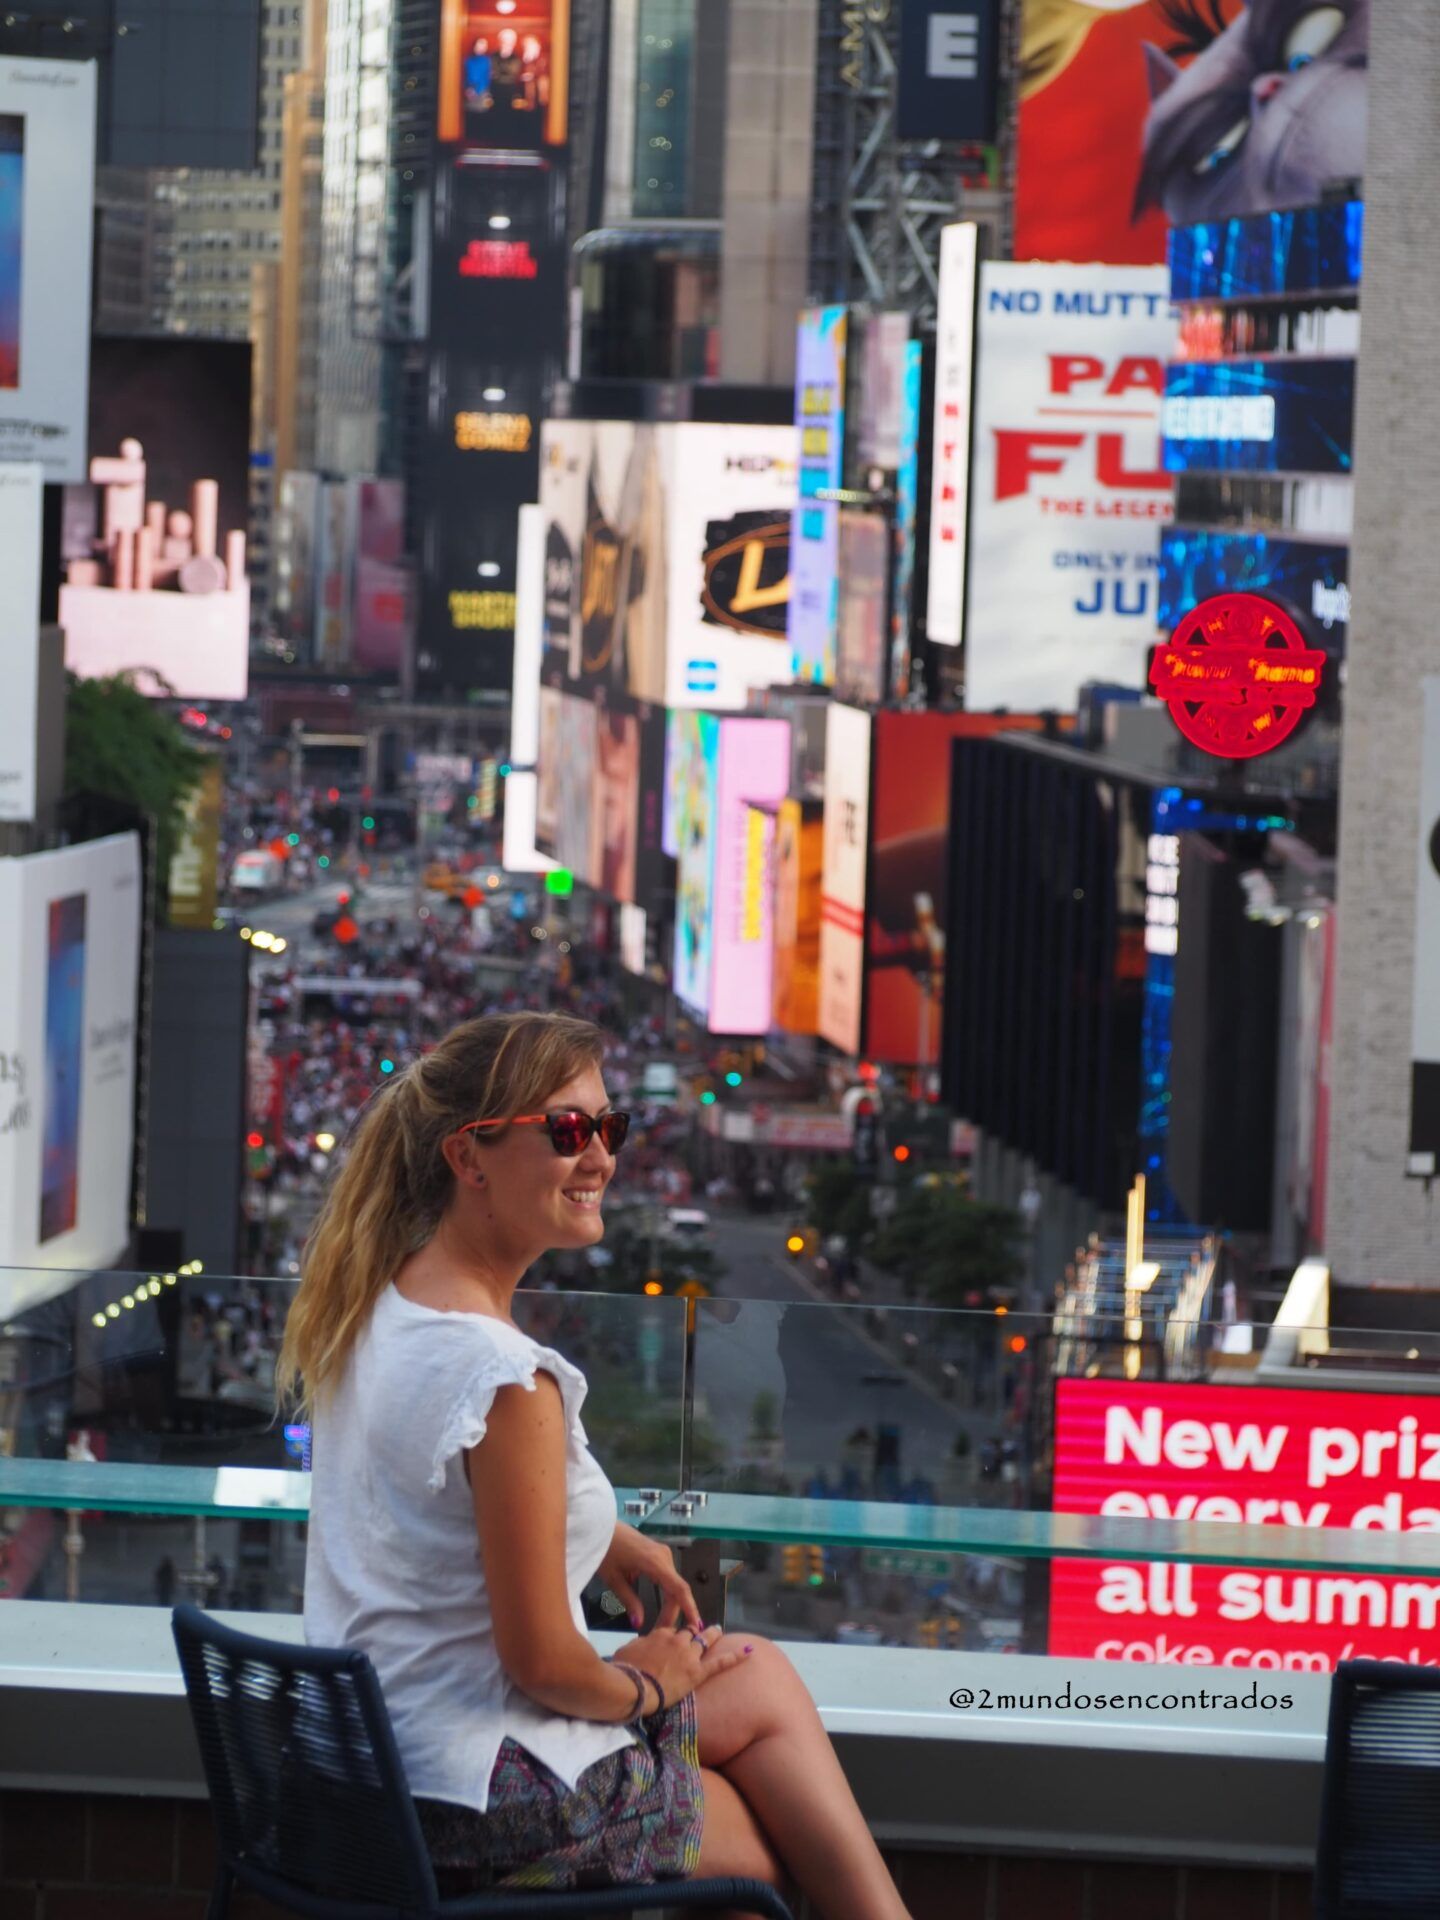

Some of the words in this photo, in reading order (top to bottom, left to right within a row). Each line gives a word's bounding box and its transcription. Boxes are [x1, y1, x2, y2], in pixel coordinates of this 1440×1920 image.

[989, 290, 1041, 313] NO
[1049, 354, 1166, 397] PA
[1040, 499, 1086, 516] THE
[1053, 551, 1127, 571] ONLY
[1075, 578, 1149, 615] JU
[1103, 1404, 1290, 1473] New
[1096, 1561, 1198, 1617] all
